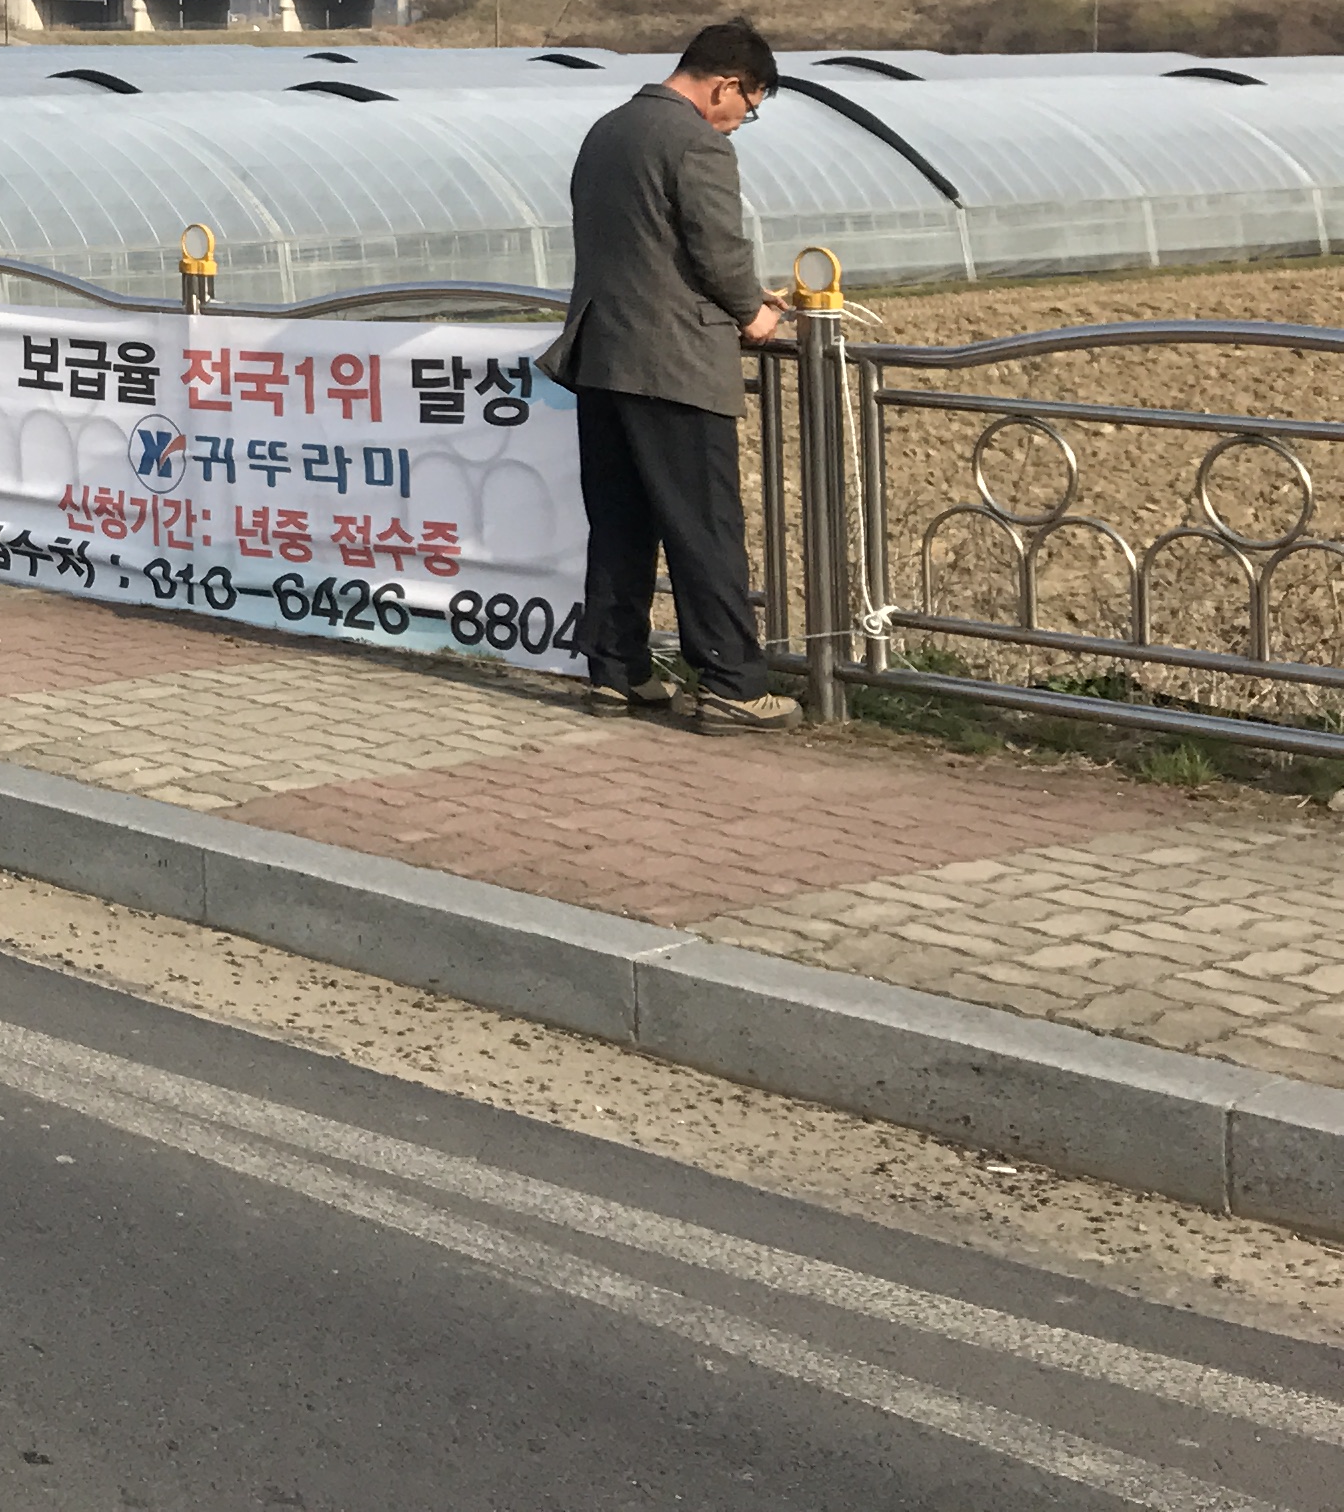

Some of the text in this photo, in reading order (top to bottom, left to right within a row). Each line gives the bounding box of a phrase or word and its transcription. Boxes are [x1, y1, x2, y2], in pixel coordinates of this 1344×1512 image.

[18, 335, 160, 407] 보급율
[180, 347, 383, 423] 전국1위
[410, 355, 534, 427] 달성
[192, 434, 411, 499] 귀뚜라미
[234, 504, 314, 563] 년중
[331, 513, 462, 578] 접수중
